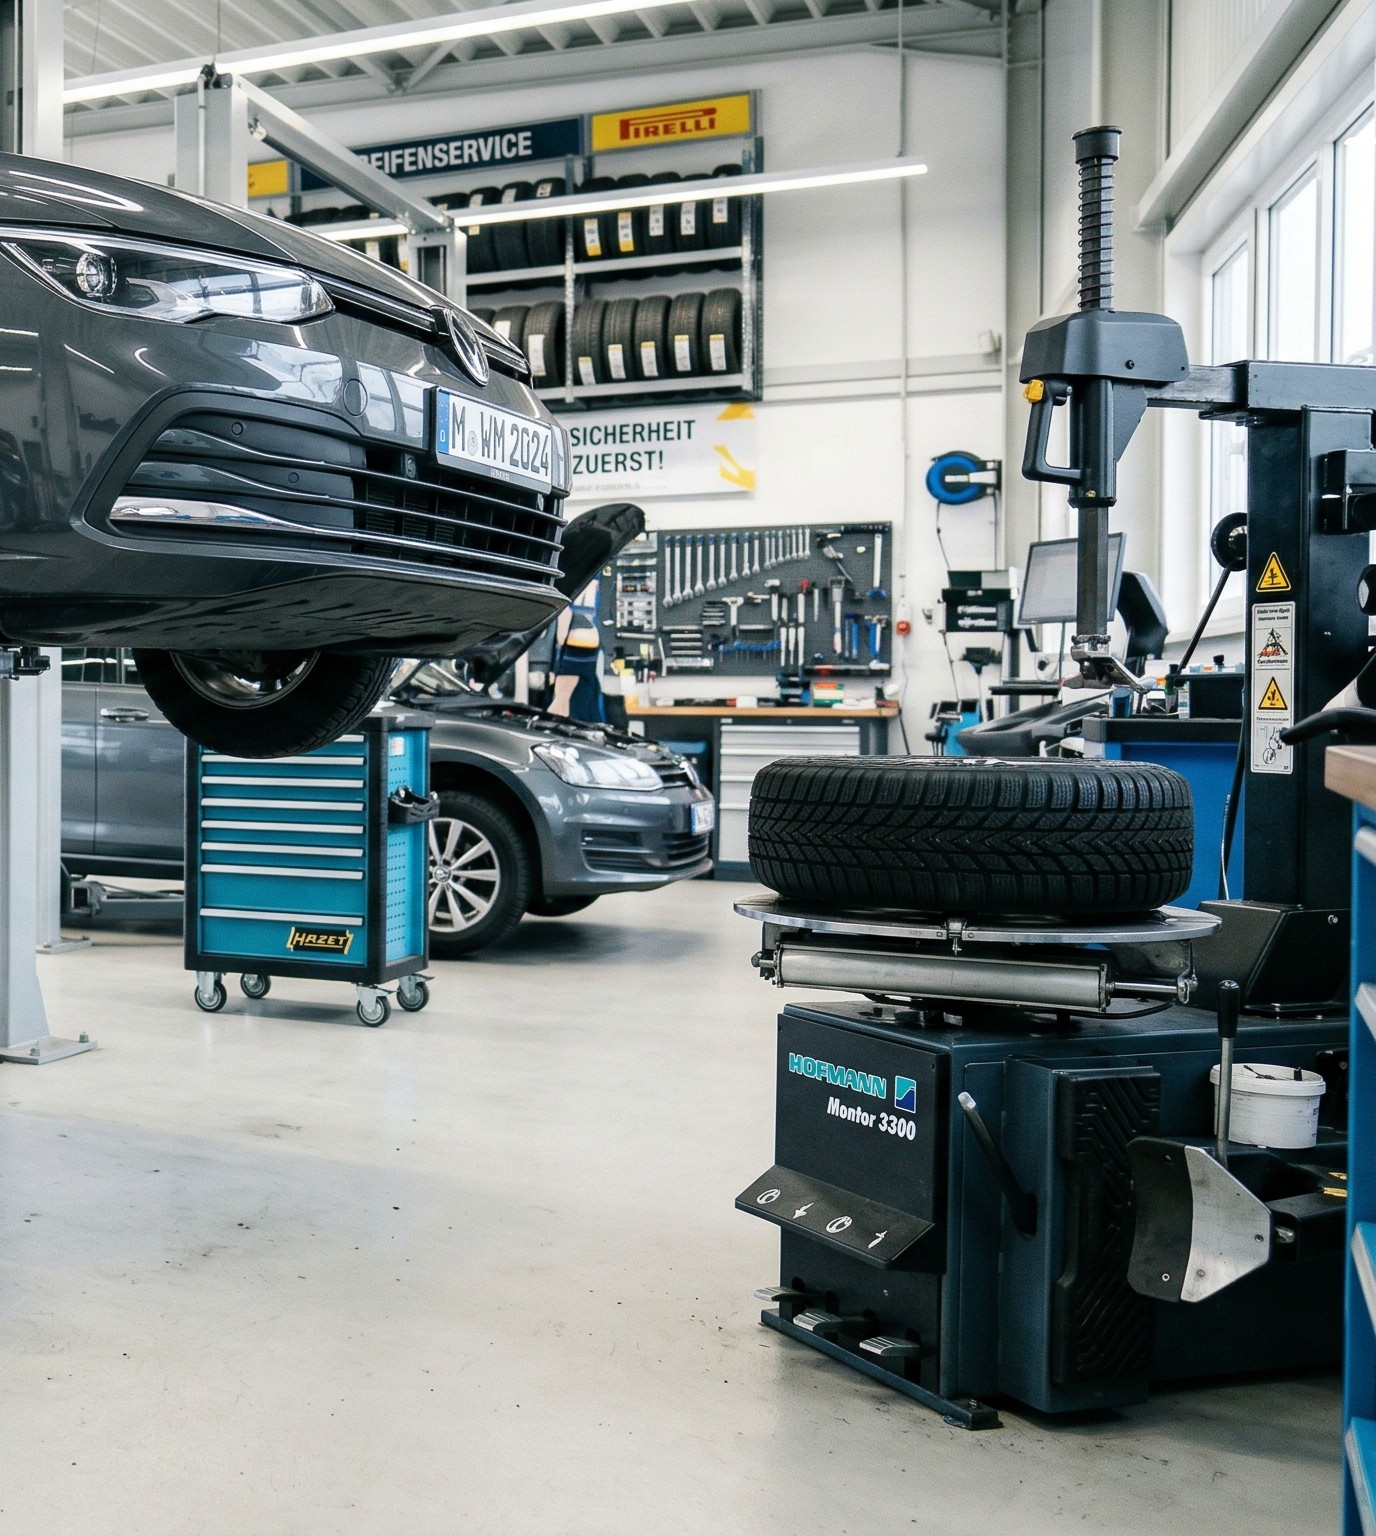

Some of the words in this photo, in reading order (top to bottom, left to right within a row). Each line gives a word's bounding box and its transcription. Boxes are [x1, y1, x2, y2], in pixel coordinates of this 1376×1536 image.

[619, 107, 717, 141] PIRELLI
[451, 402, 466, 452] M
[480, 411, 505, 463] WM
[509, 423, 549, 477] 2024
[569, 419, 696, 447] SICHERHEIT
[572, 450, 664, 475] ZUERST!
[290, 931, 349, 949] HAZET
[788, 1052, 887, 1100] HOFMANN
[826, 1096, 877, 1128] Montor
[878, 1112, 917, 1141] 3300
